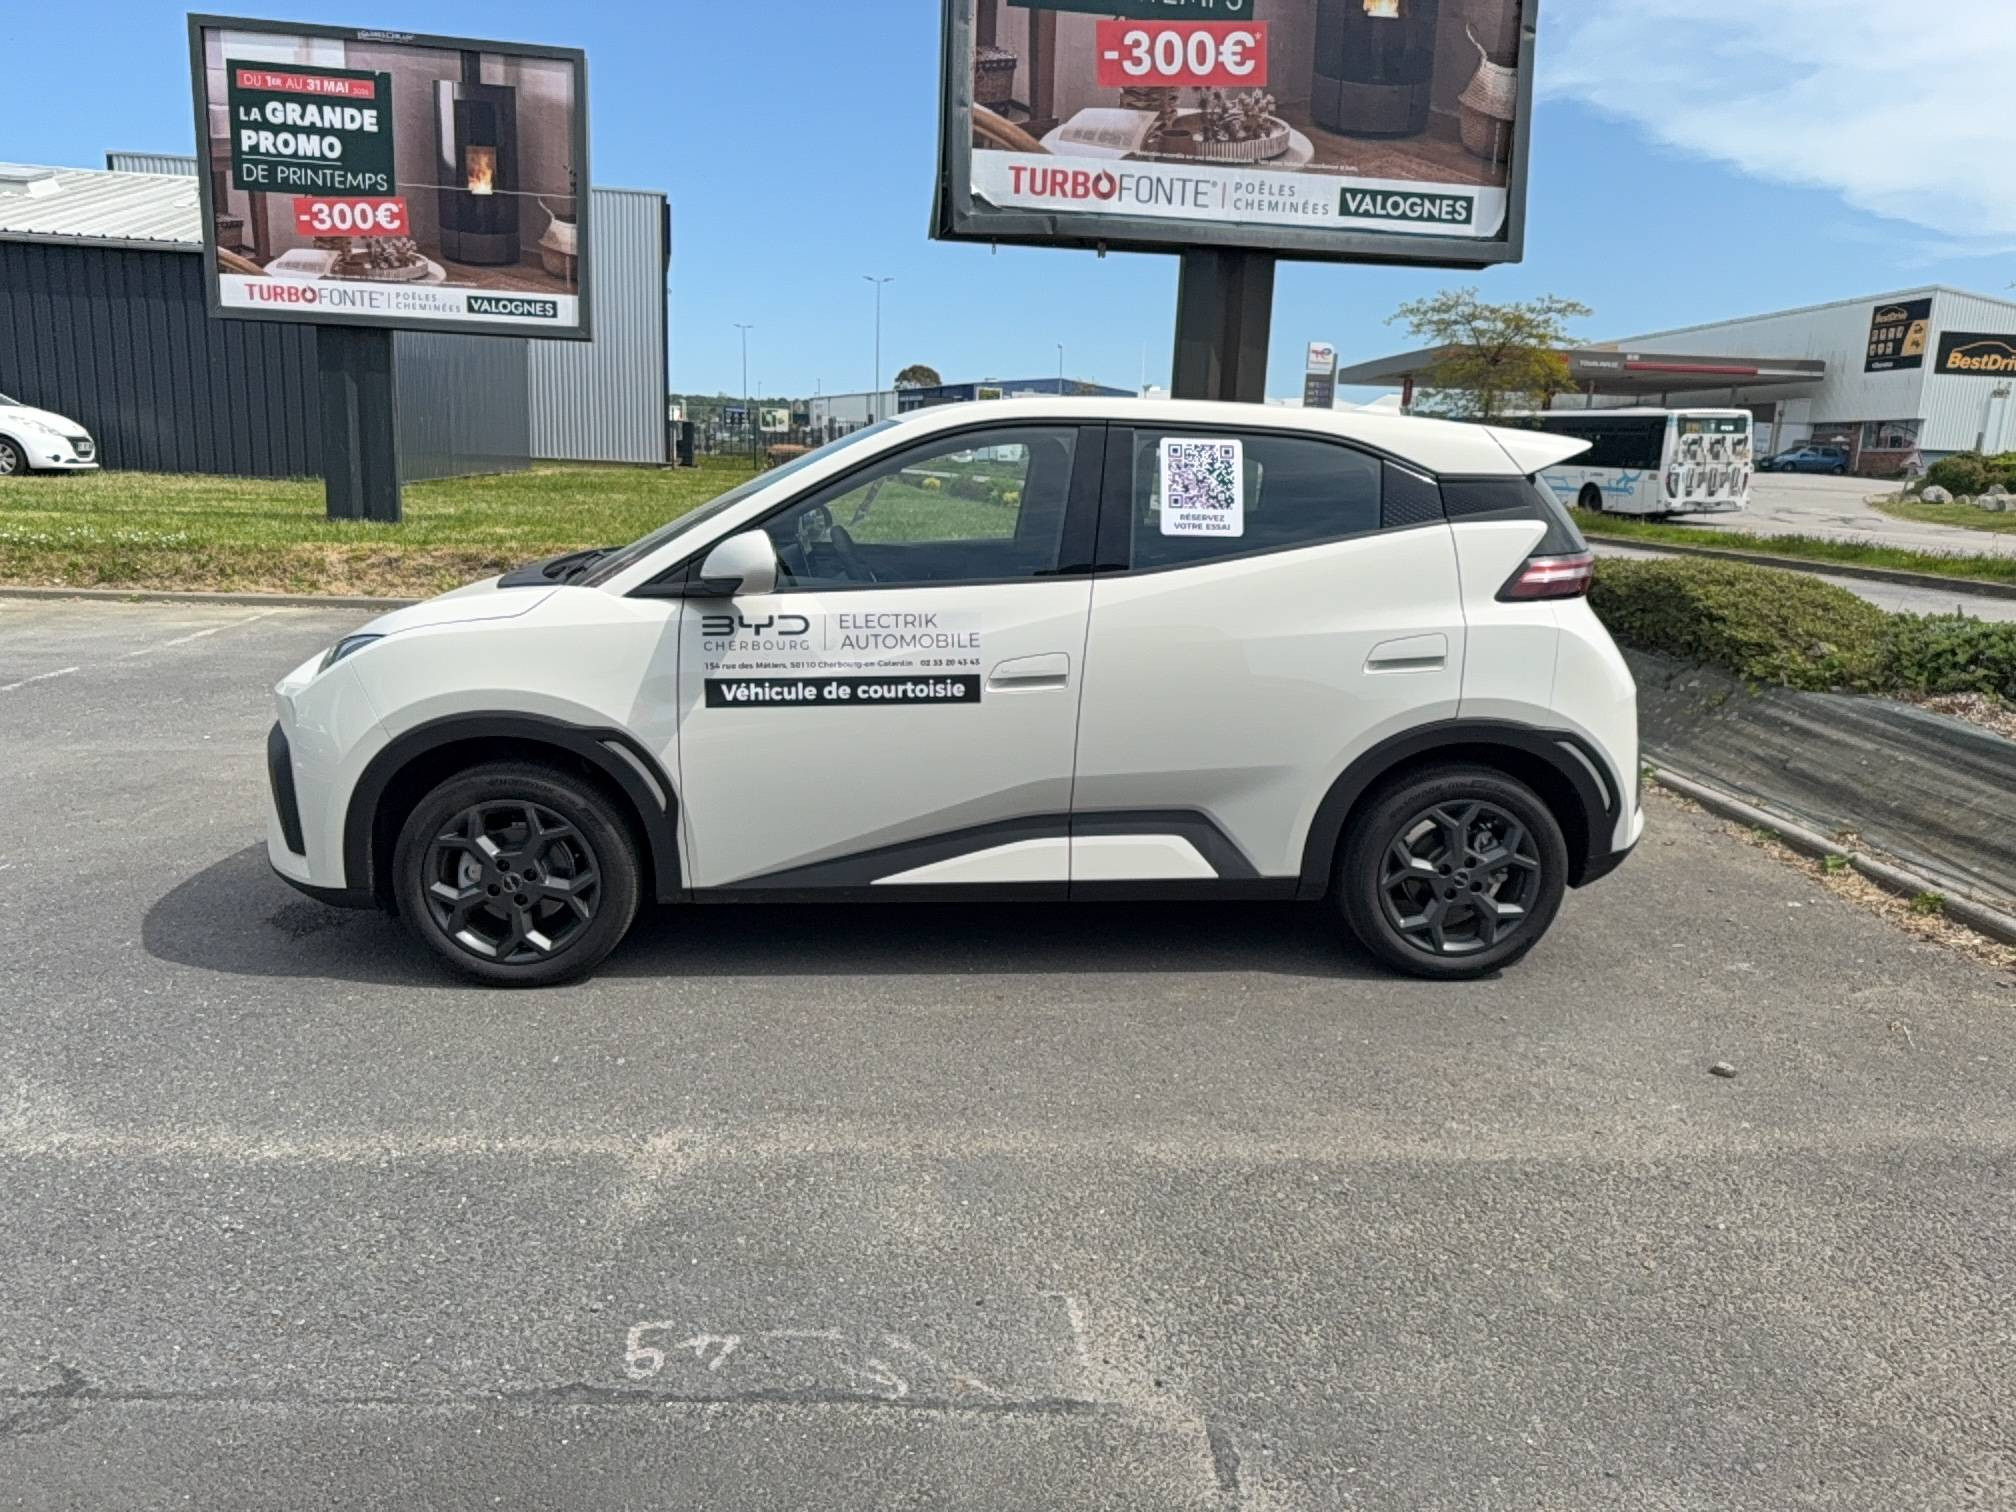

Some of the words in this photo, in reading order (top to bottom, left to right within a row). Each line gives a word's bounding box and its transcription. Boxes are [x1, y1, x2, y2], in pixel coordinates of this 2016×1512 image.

[243, 73, 262, 87] DU
[285, 77, 303, 90] AU
[306, 79, 321, 91] 31
[323, 81, 349, 93] MAI
[239, 105, 263, 123] LA
[265, 101, 379, 133] GRANDE
[240, 128, 343, 160] PROMO
[242, 163, 270, 183] DE
[276, 165, 389, 192] PRINTEMPS
[1234, 181, 1297, 198] POÊLES
[1233, 197, 1330, 216] CHEMINÉES
[1345, 192, 1468, 222] VALOGNES
[470, 298, 556, 317] VALOGNES
[1174, 522, 1203, 530] VOTRE
[701, 614, 811, 637] BYD
[839, 613, 938, 630] ELECTRIK
[703, 640, 810, 651] CHERBOURG
[840, 632, 980, 650] AUTOMOBILE
[721, 662, 737, 670] rue
[737, 661, 754, 669] des
[720, 680, 817, 701] Véhicule
[823, 681, 851, 699] de
[857, 680, 966, 699] courtoisie
